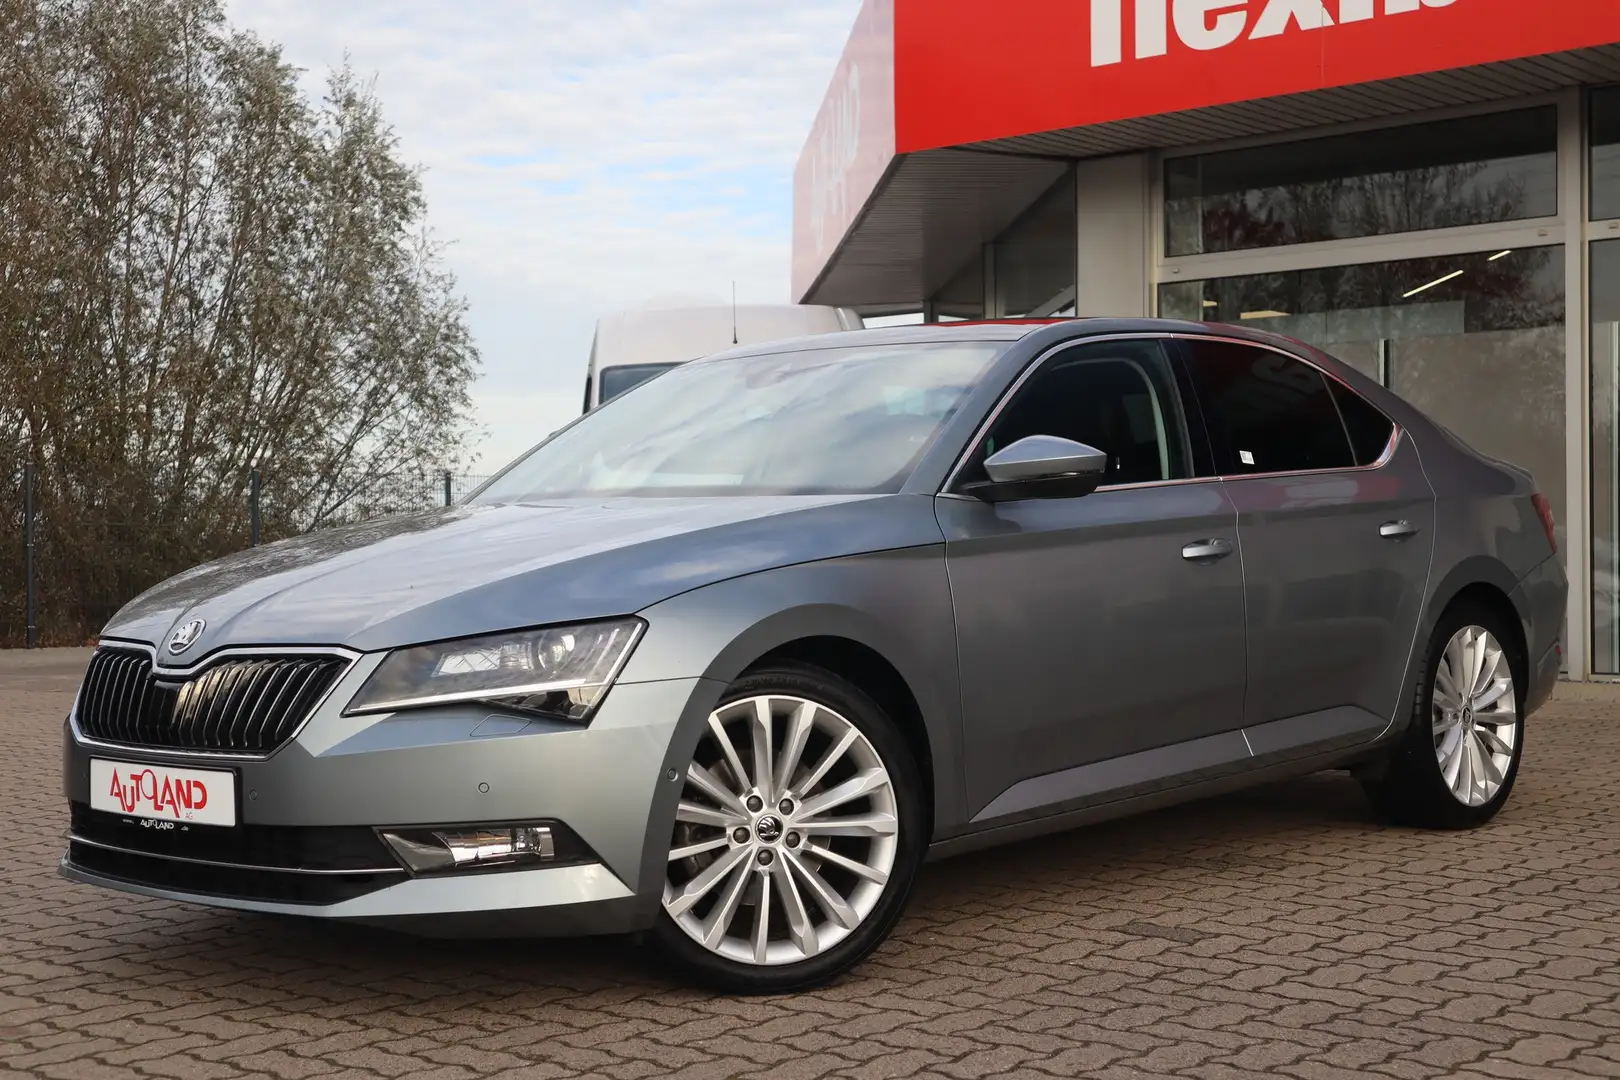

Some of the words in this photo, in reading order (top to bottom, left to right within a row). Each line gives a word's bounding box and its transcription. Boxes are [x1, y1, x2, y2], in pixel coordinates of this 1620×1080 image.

[110, 767, 207, 818] AUTOLAND
[185, 812, 193, 820] AG
[140, 819, 174, 830] AUTOLAND
